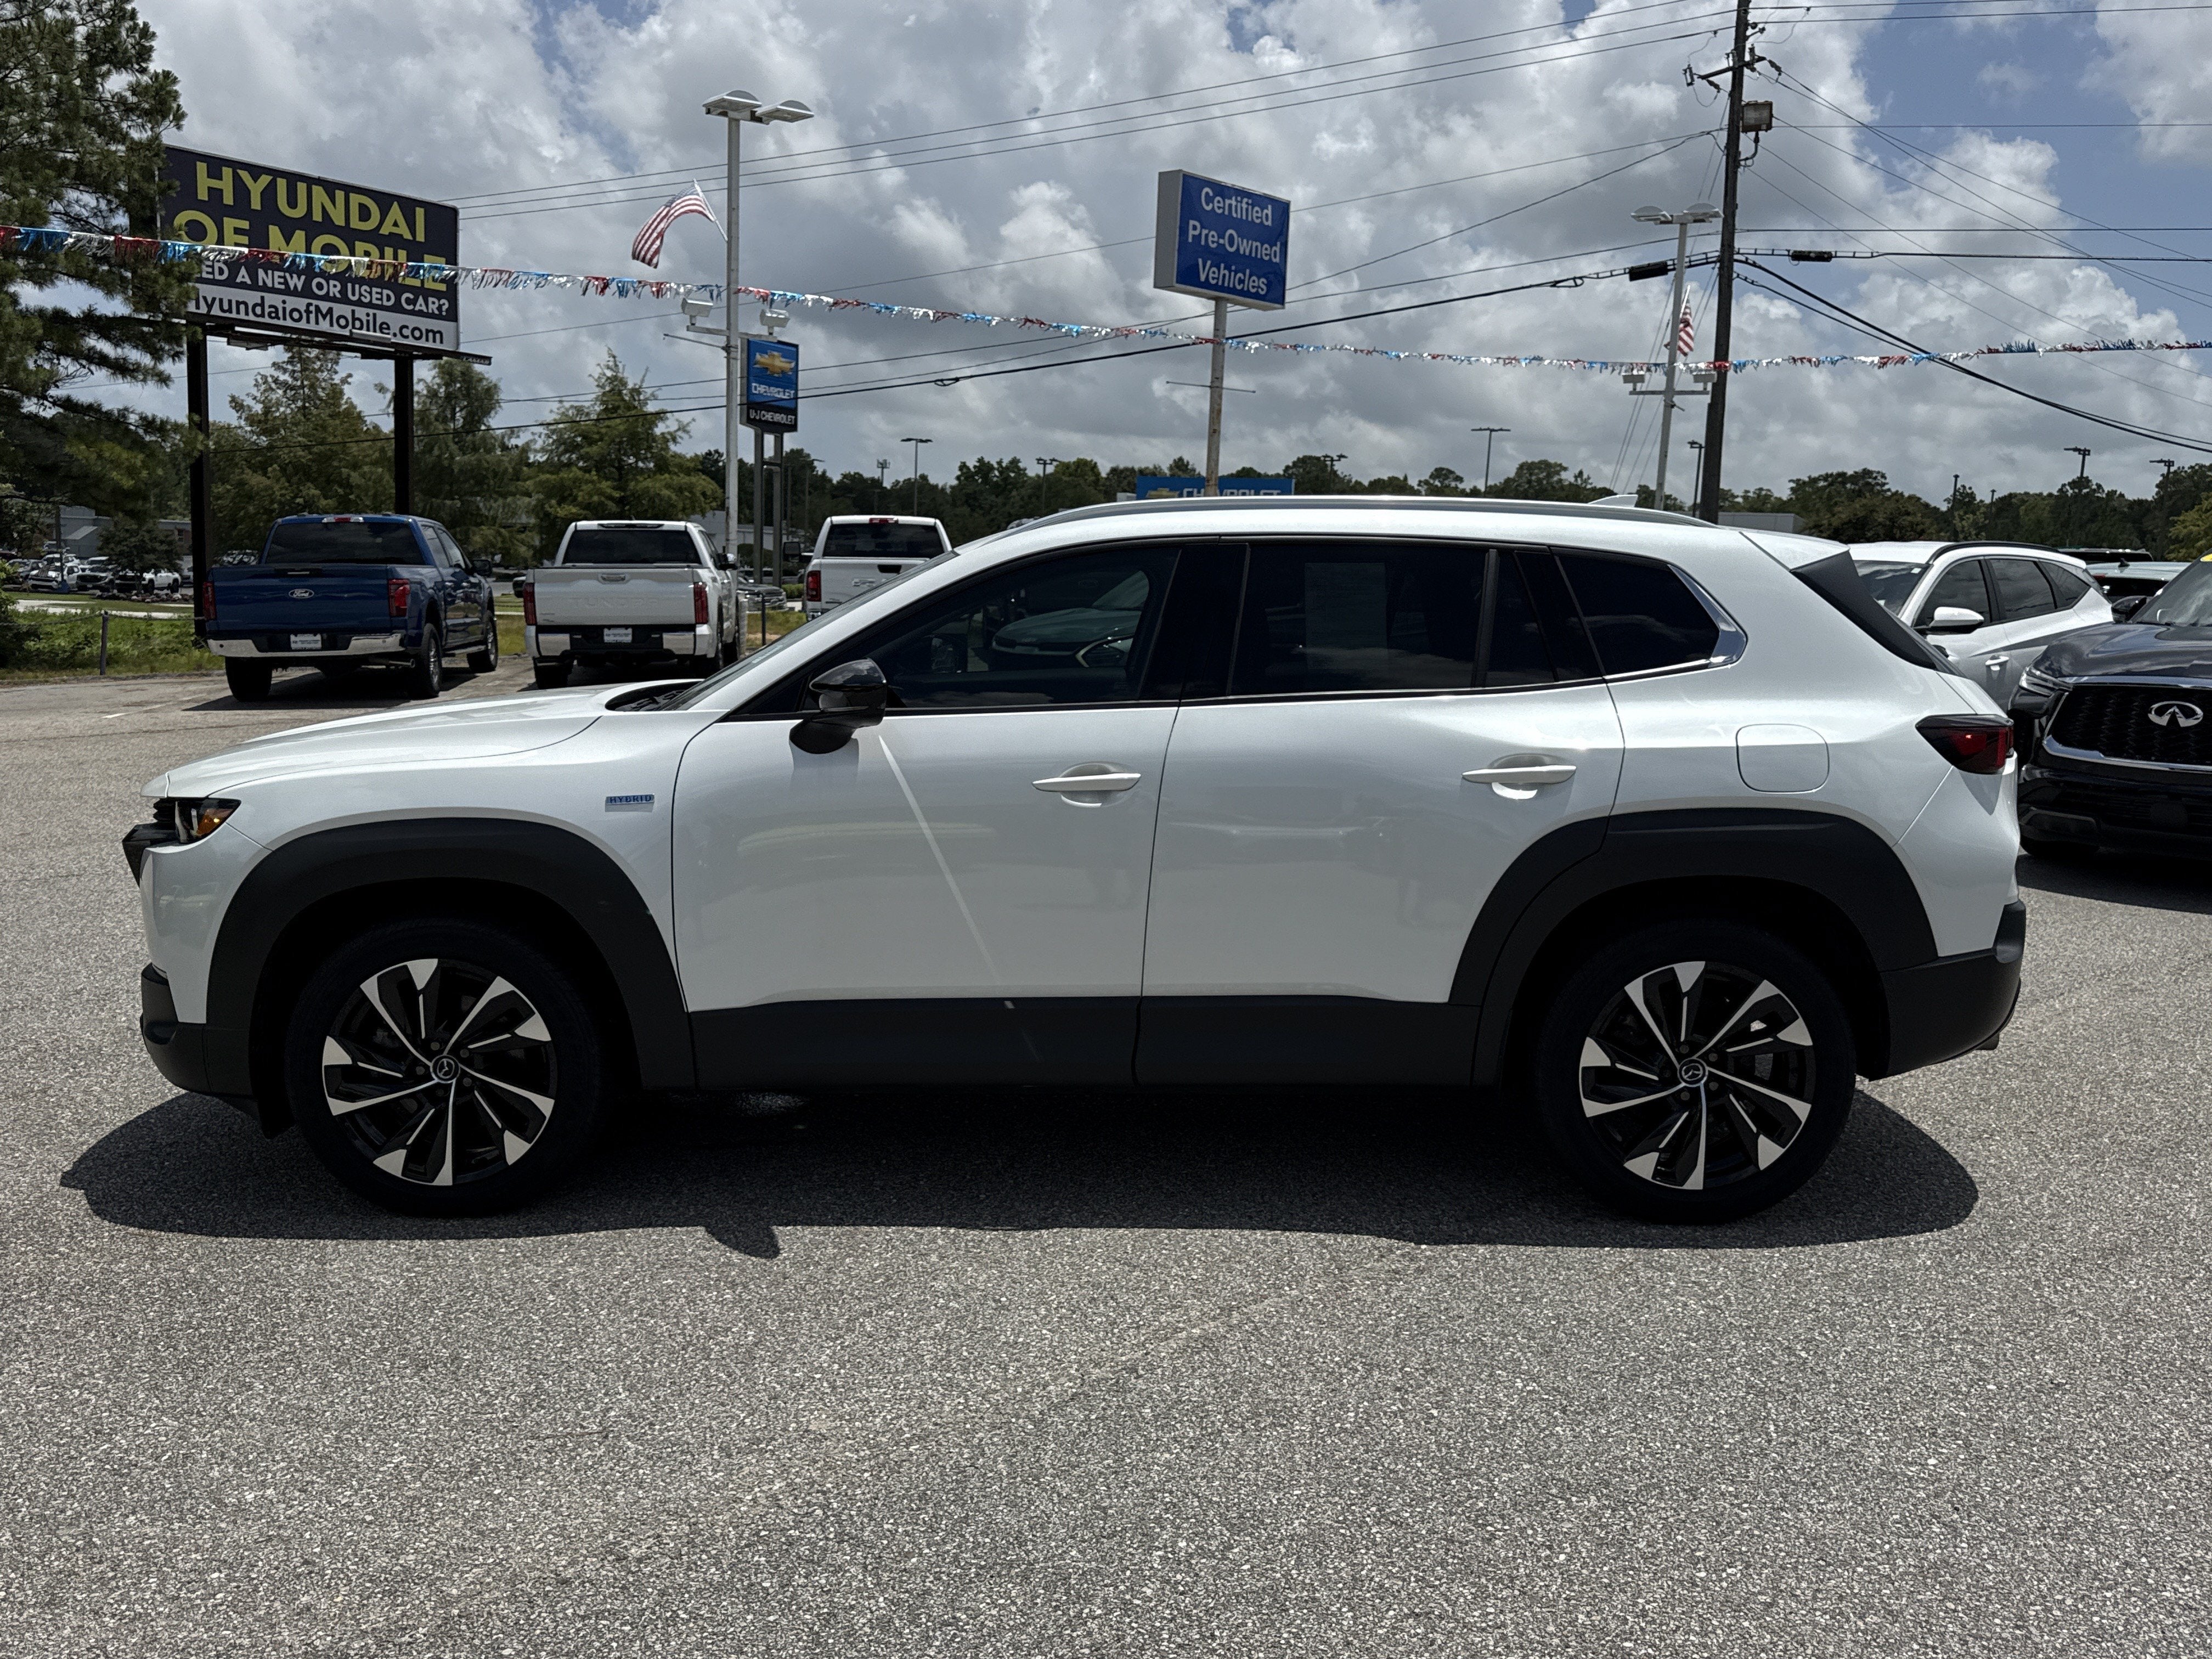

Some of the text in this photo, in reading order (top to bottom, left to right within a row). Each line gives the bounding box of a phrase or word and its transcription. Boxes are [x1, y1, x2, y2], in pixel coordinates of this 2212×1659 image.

[196, 161, 425, 242] HYUNDAI
[1201, 187, 1272, 227] Certified
[173, 210, 447, 291] OF MOBILE
[1188, 220, 1280, 263] Pre-Owned
[195, 261, 449, 316] ED A NEW OR USED CAR?
[1198, 258, 1268, 295] Vehicles
[752, 383, 795, 399] CHEVROLET
[749, 409, 795, 425] U-J CHEVROLET
[610, 795, 652, 803] HYBRID
